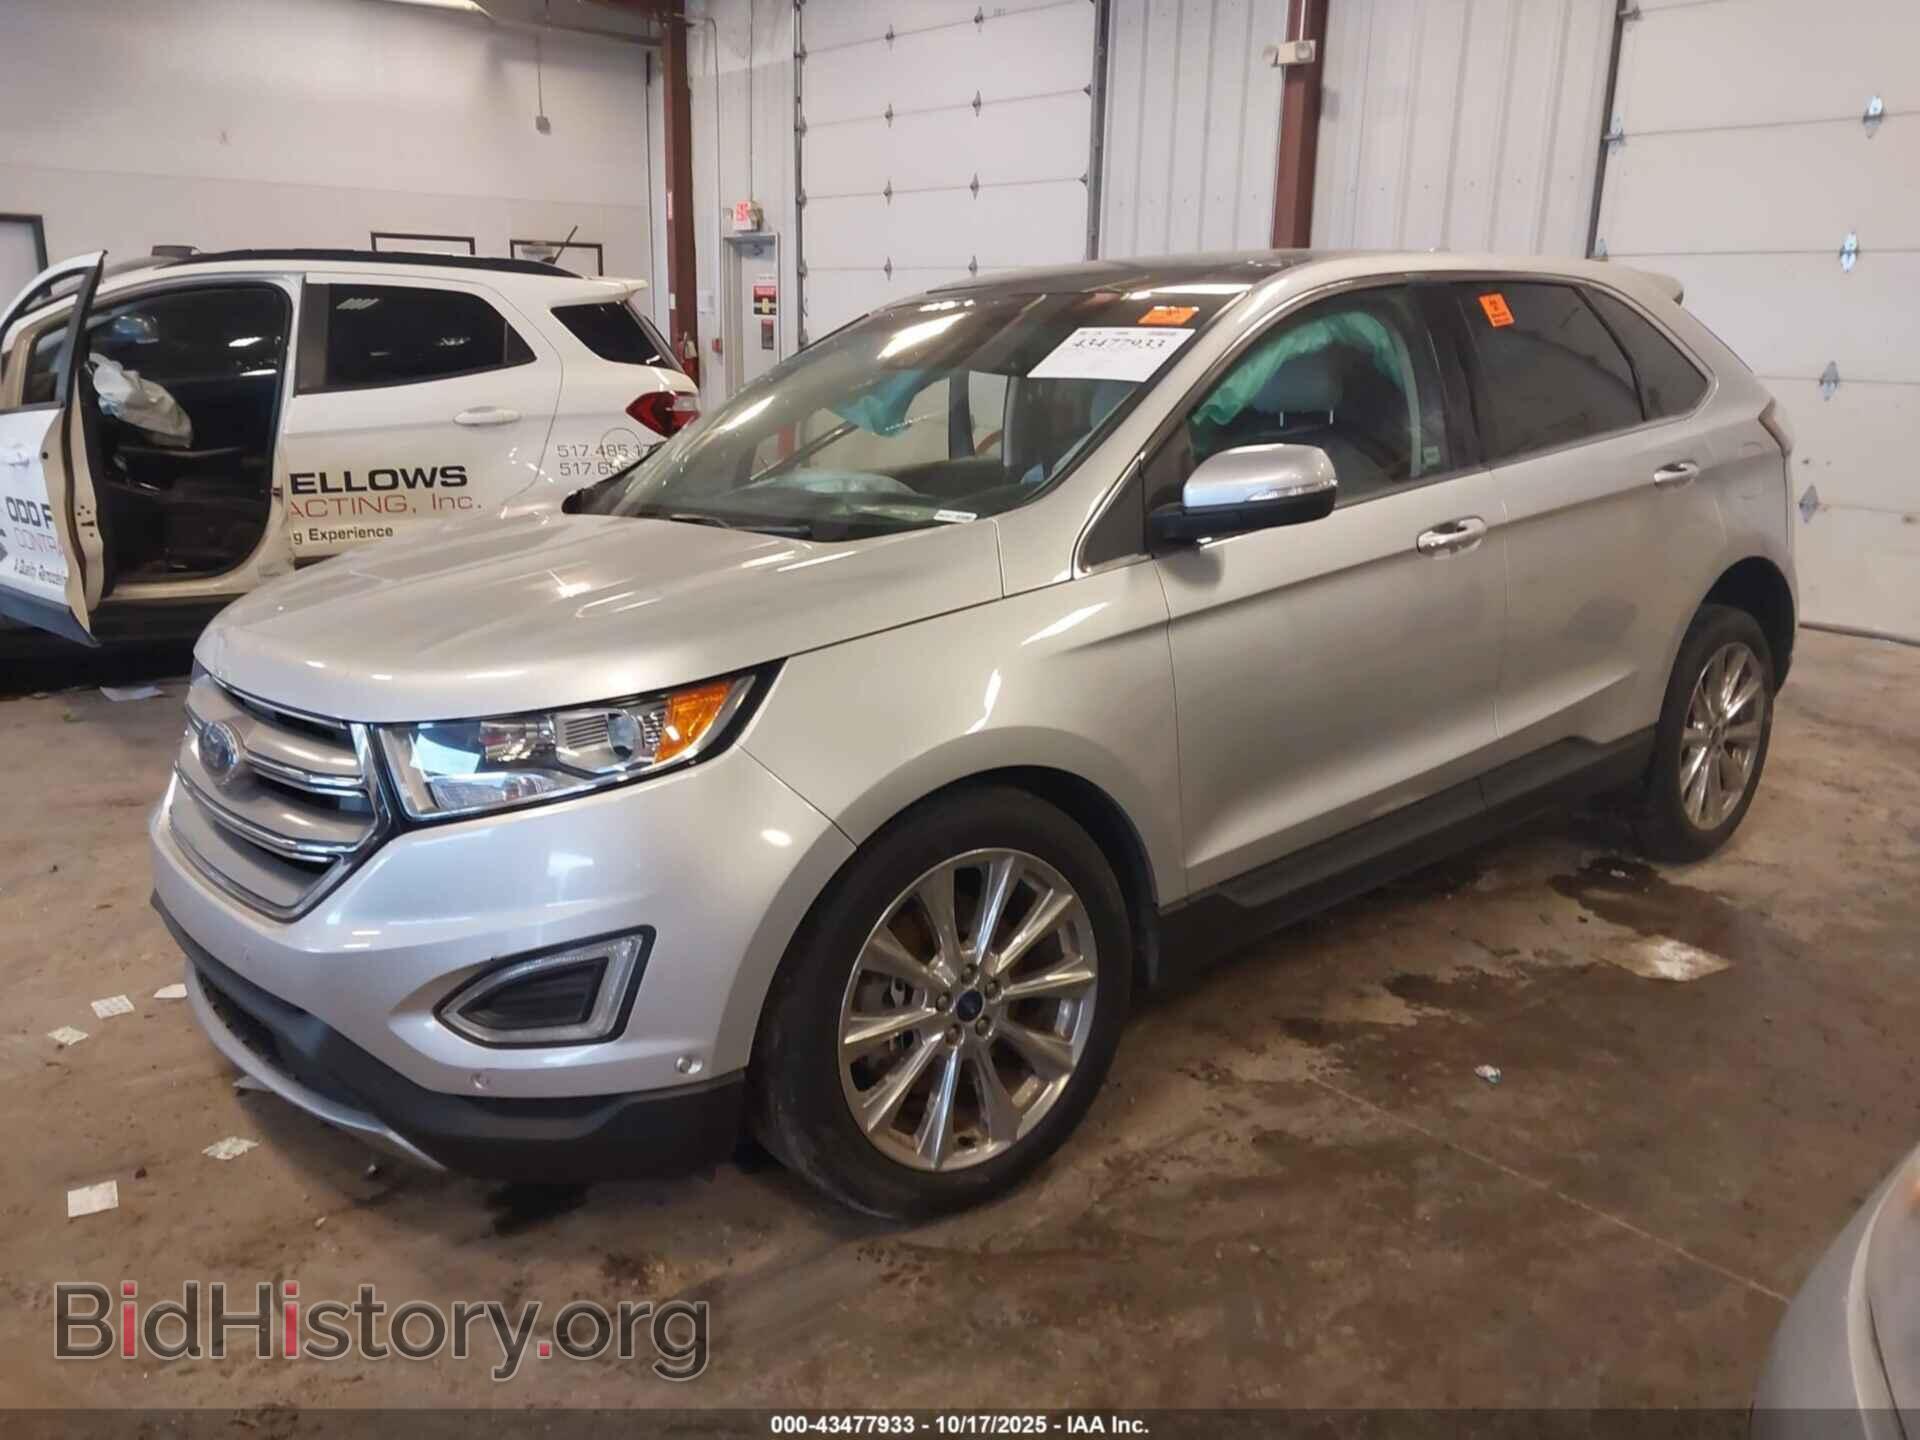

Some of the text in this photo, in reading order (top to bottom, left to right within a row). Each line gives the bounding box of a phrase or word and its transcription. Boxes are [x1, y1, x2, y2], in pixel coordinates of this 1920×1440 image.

[432, 493, 481, 511] Inc.
[6, 496, 42, 527] ODD
[309, 525, 394, 543] Experience
